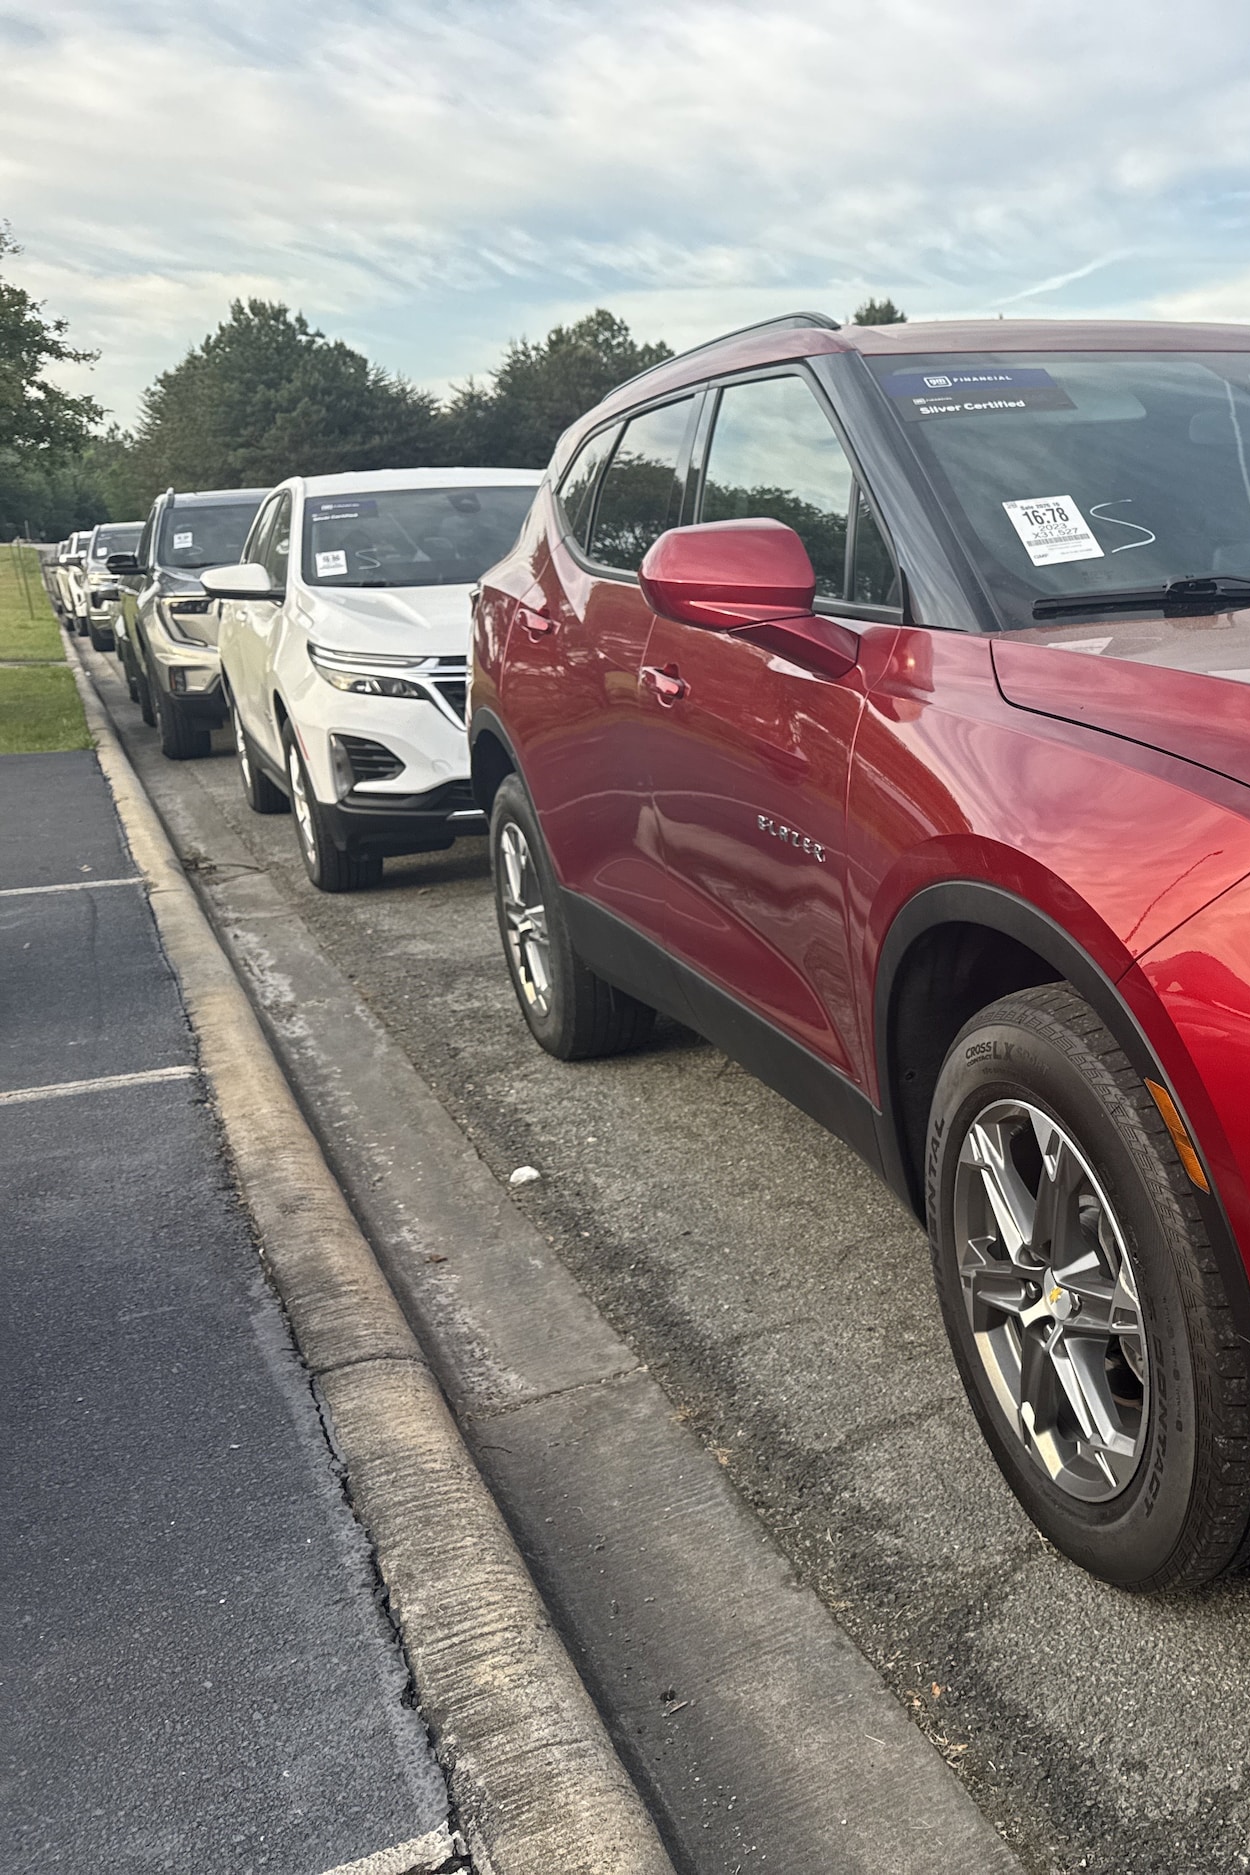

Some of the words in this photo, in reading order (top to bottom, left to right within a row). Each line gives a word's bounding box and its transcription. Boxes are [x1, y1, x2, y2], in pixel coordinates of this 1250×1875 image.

[953, 375, 1013, 383] FINANCIAL
[919, 404, 961, 415] Silver
[963, 400, 1026, 411] Certified
[1022, 507, 1069, 526] 16:78
[1039, 523, 1067, 531] 2023
[758, 814, 826, 862] BLAZER
[965, 1041, 992, 1060] CROSS
